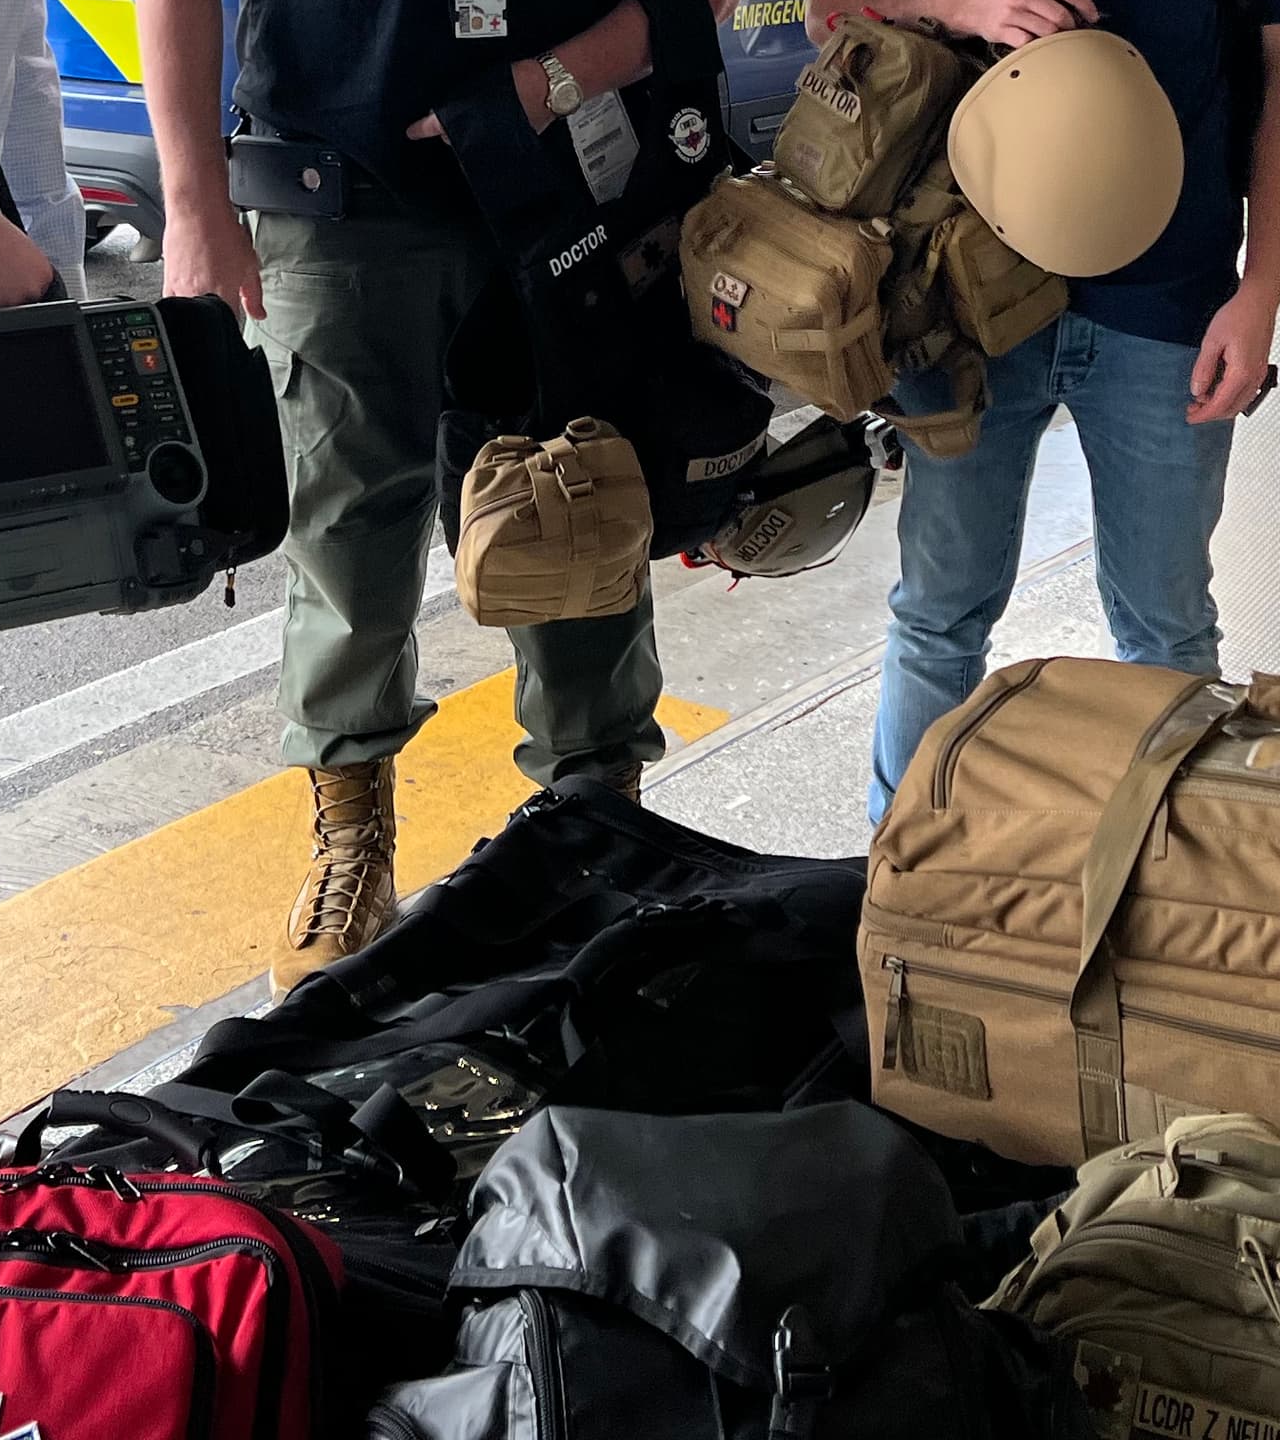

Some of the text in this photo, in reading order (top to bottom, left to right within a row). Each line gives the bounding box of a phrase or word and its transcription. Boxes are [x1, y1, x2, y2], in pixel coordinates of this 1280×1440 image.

[802, 70, 858, 118] DOCTOR
[549, 224, 609, 279] DOCTOR
[734, 513, 787, 563] DOCTOR
[1139, 1389, 1195, 1438] LCDR
